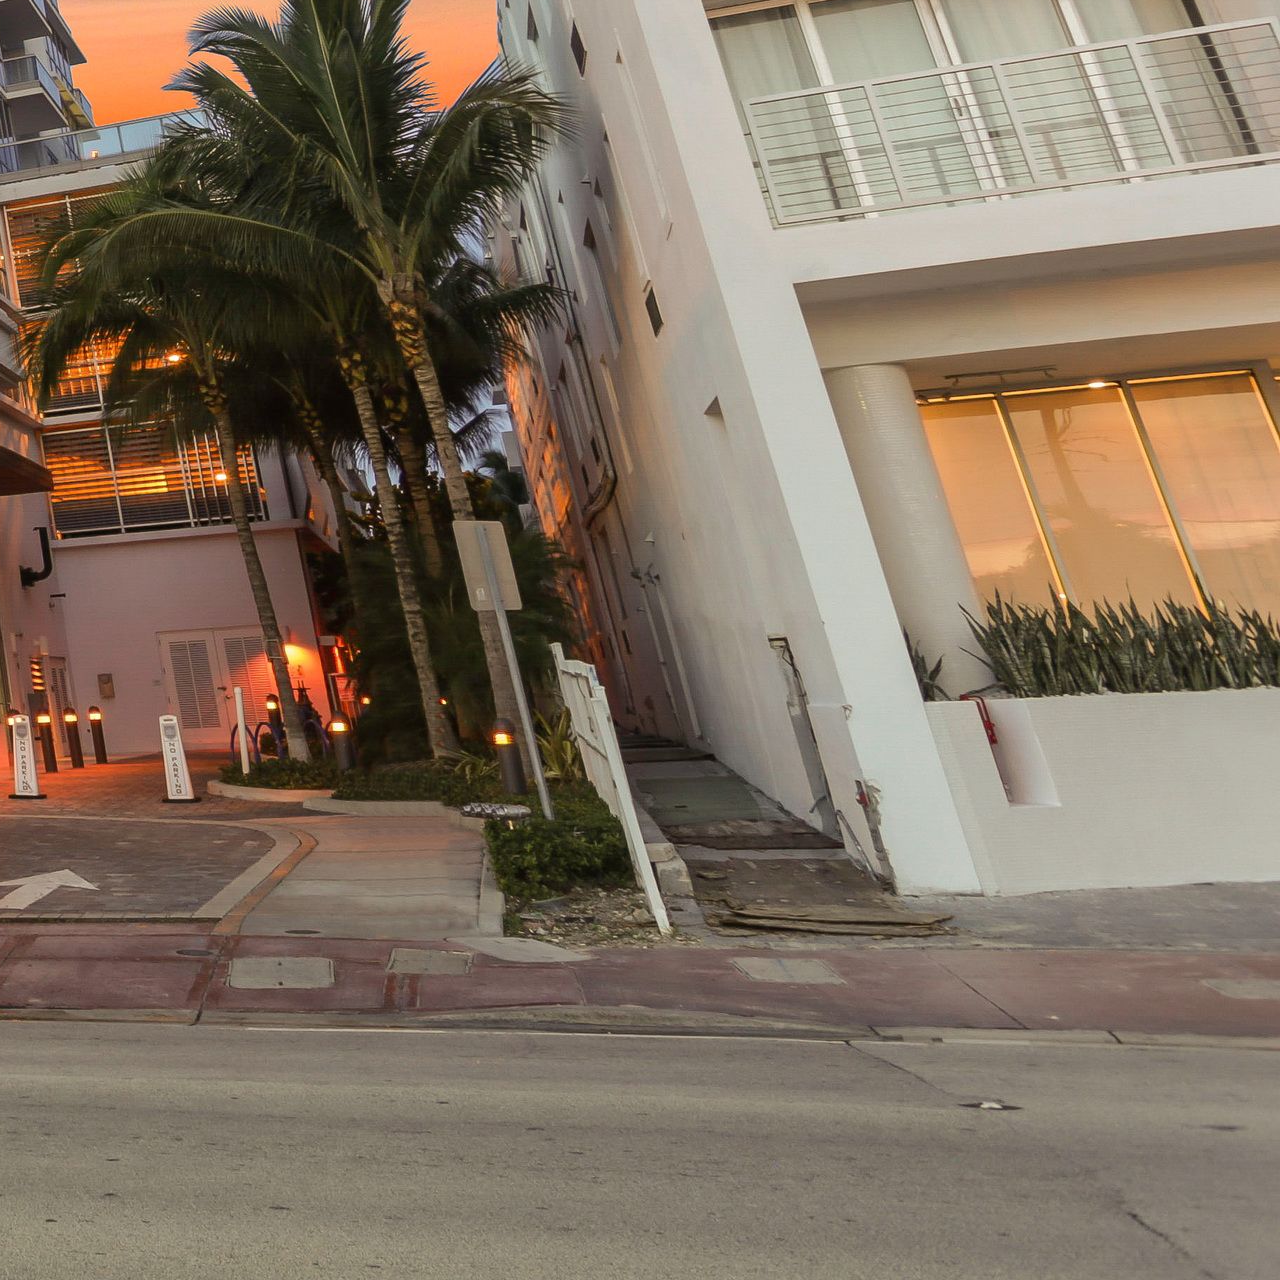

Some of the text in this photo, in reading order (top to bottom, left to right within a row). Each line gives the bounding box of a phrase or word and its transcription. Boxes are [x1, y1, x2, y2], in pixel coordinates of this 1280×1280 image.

[19, 740, 26, 751] NO
[168, 742, 176, 754] NO
[171, 757, 182, 794] PARKING
